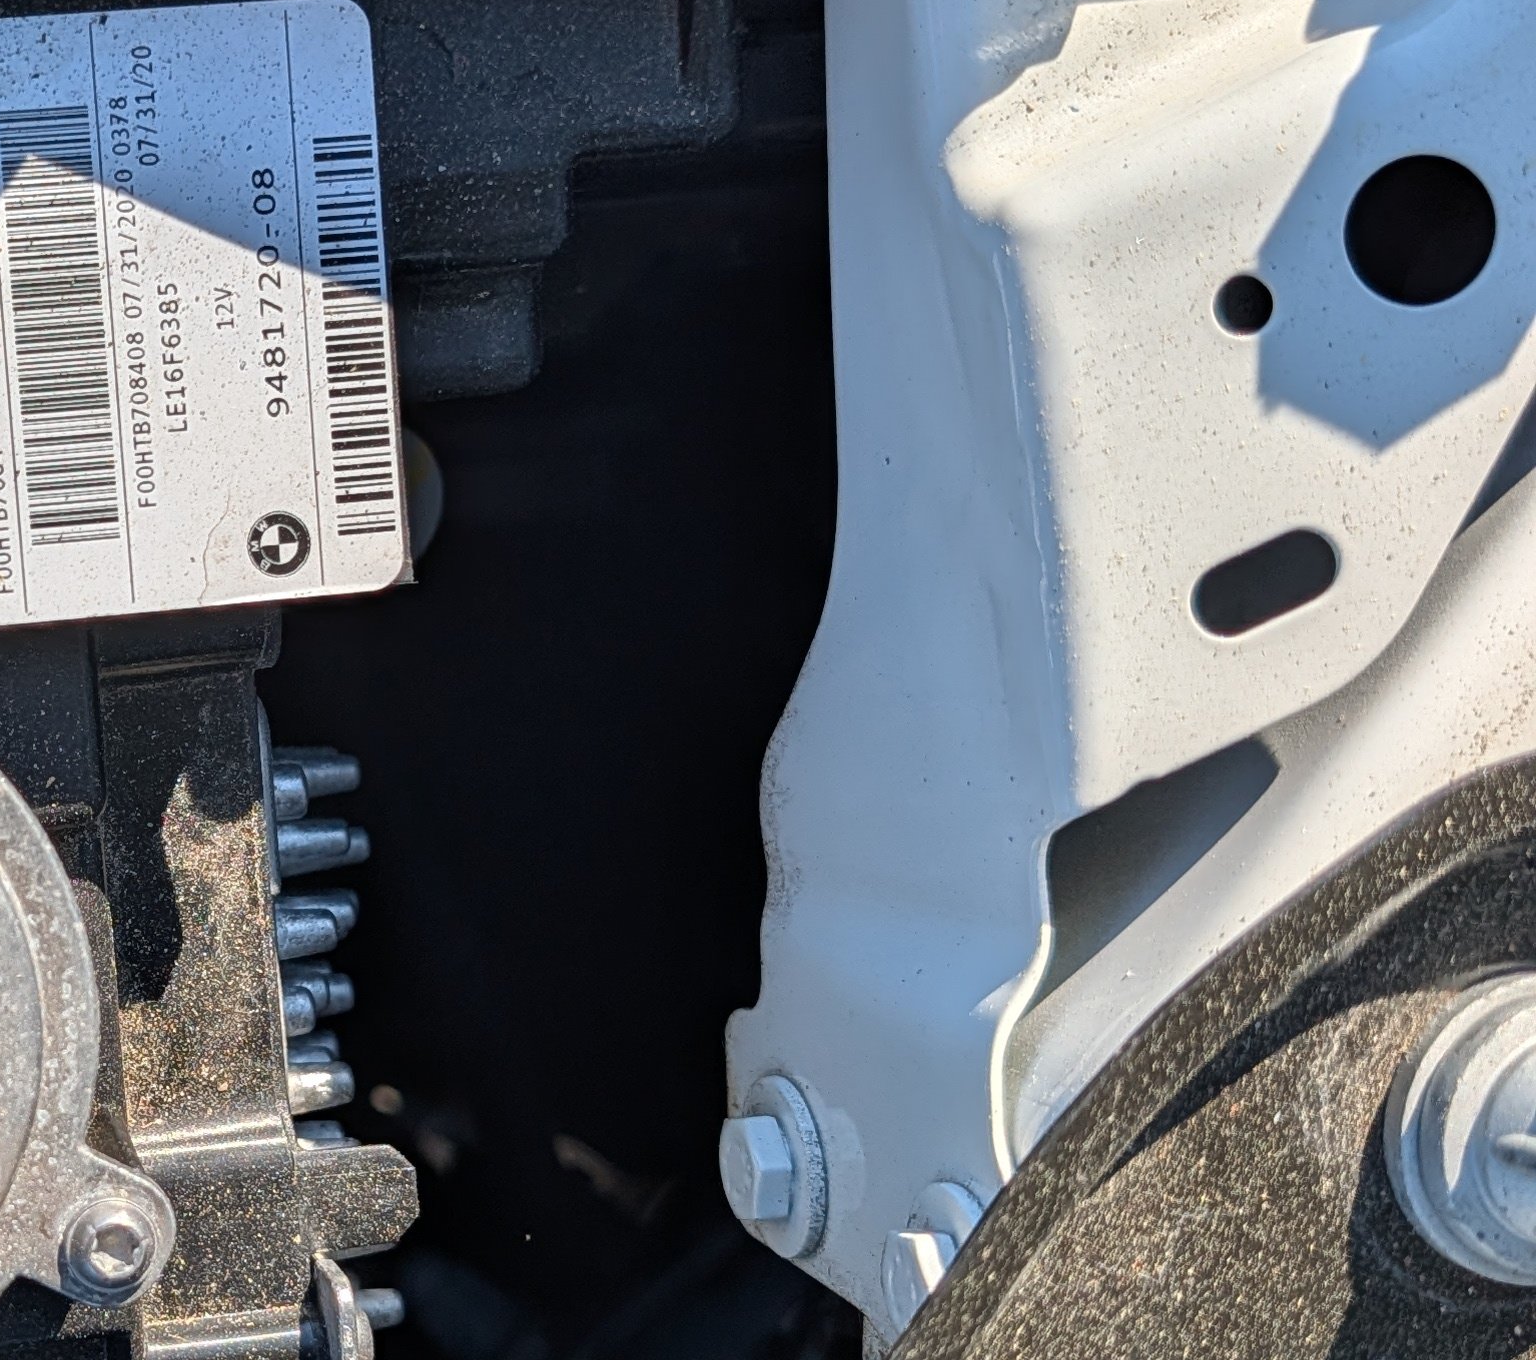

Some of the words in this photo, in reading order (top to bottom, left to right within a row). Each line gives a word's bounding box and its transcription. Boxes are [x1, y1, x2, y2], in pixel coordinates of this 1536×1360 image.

[108, 95, 132, 157] 0378
[131, 45, 161, 167] 07/31/20
[114, 168, 144, 319] 07/31/2020
[251, 167, 291, 419] 9481720-08
[156, 282, 189, 433] LE16F6385
[214, 287, 236, 330] 12V
[251, 520, 272, 572] BMW
